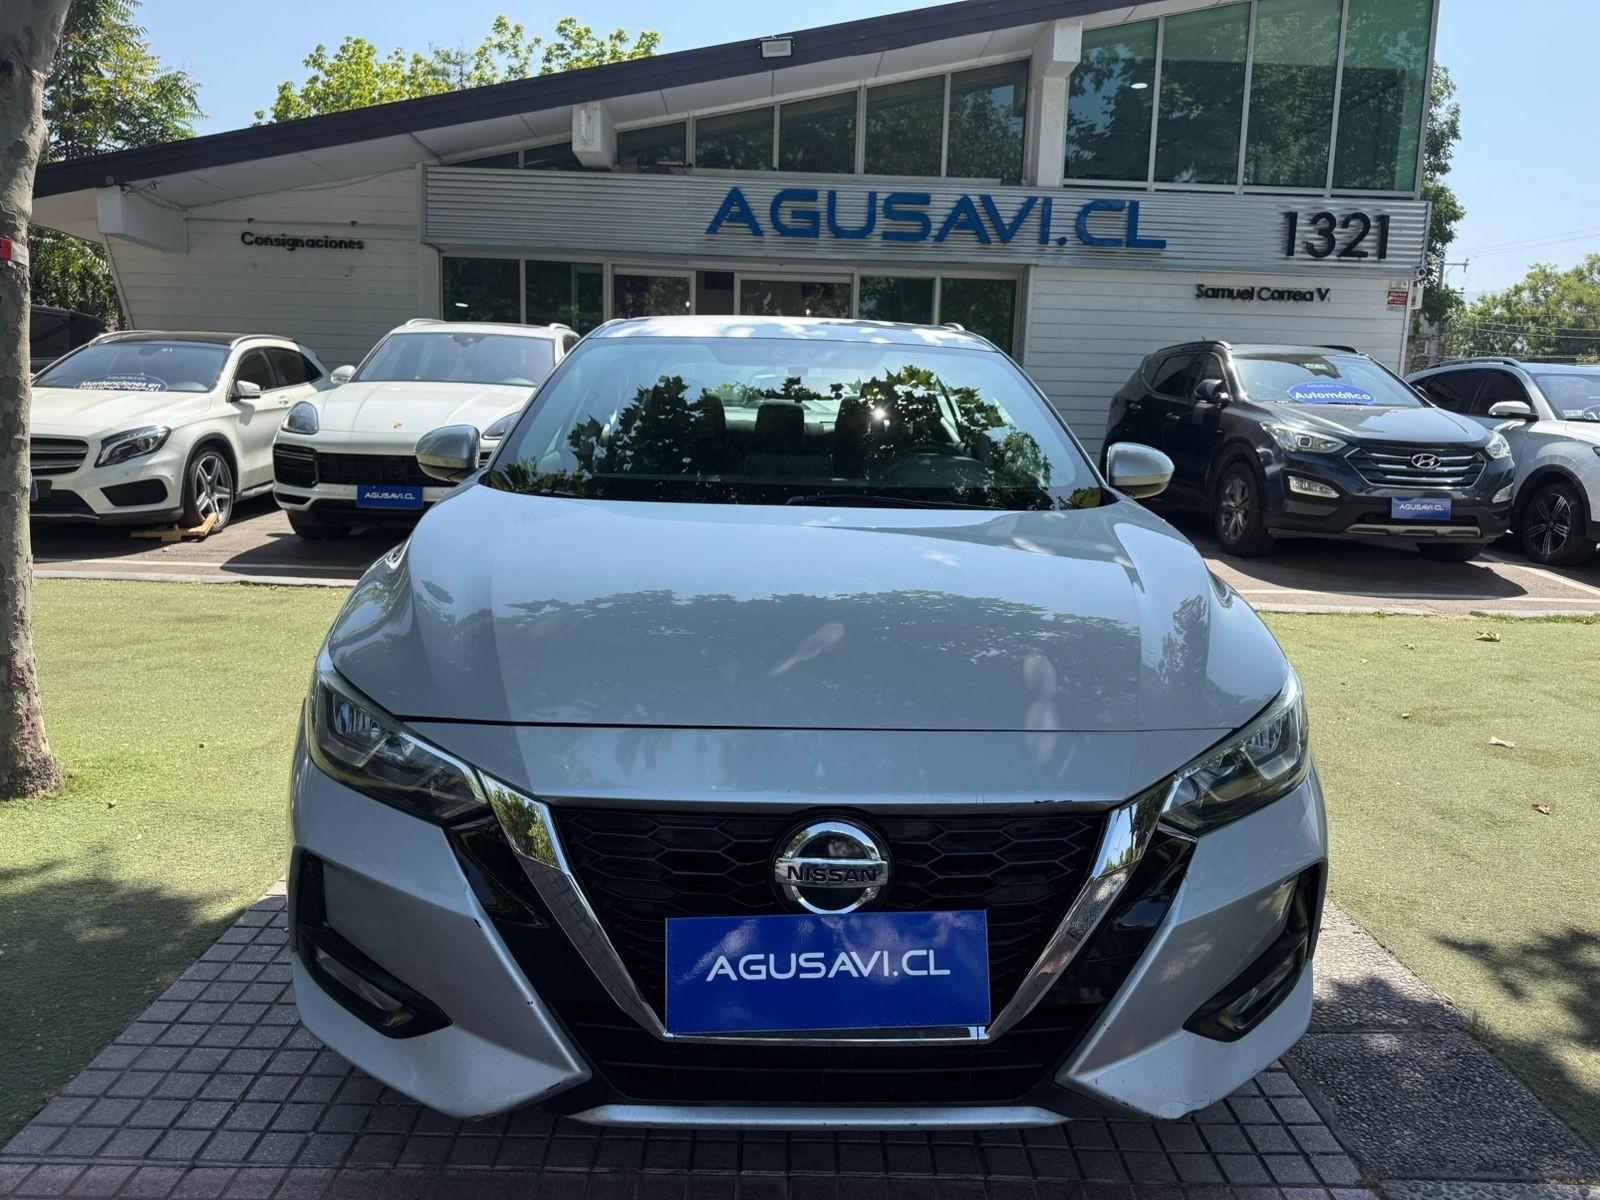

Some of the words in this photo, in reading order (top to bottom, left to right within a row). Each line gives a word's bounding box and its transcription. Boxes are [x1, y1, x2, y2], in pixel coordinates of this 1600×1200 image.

[705, 187, 1166, 249] AGUSAVI.CL
[241, 231, 364, 251] Consignaciones
[1284, 211, 1390, 260] 1321
[1196, 284, 1254, 301] Samuel
[1257, 287, 1314, 302] Correa
[364, 491, 416, 500] AGUSAVI.CL
[1400, 503, 1444, 511] AGUSAVI.CL
[787, 864, 878, 883] NISSAN
[705, 949, 951, 982] AGUSAVI.CL
